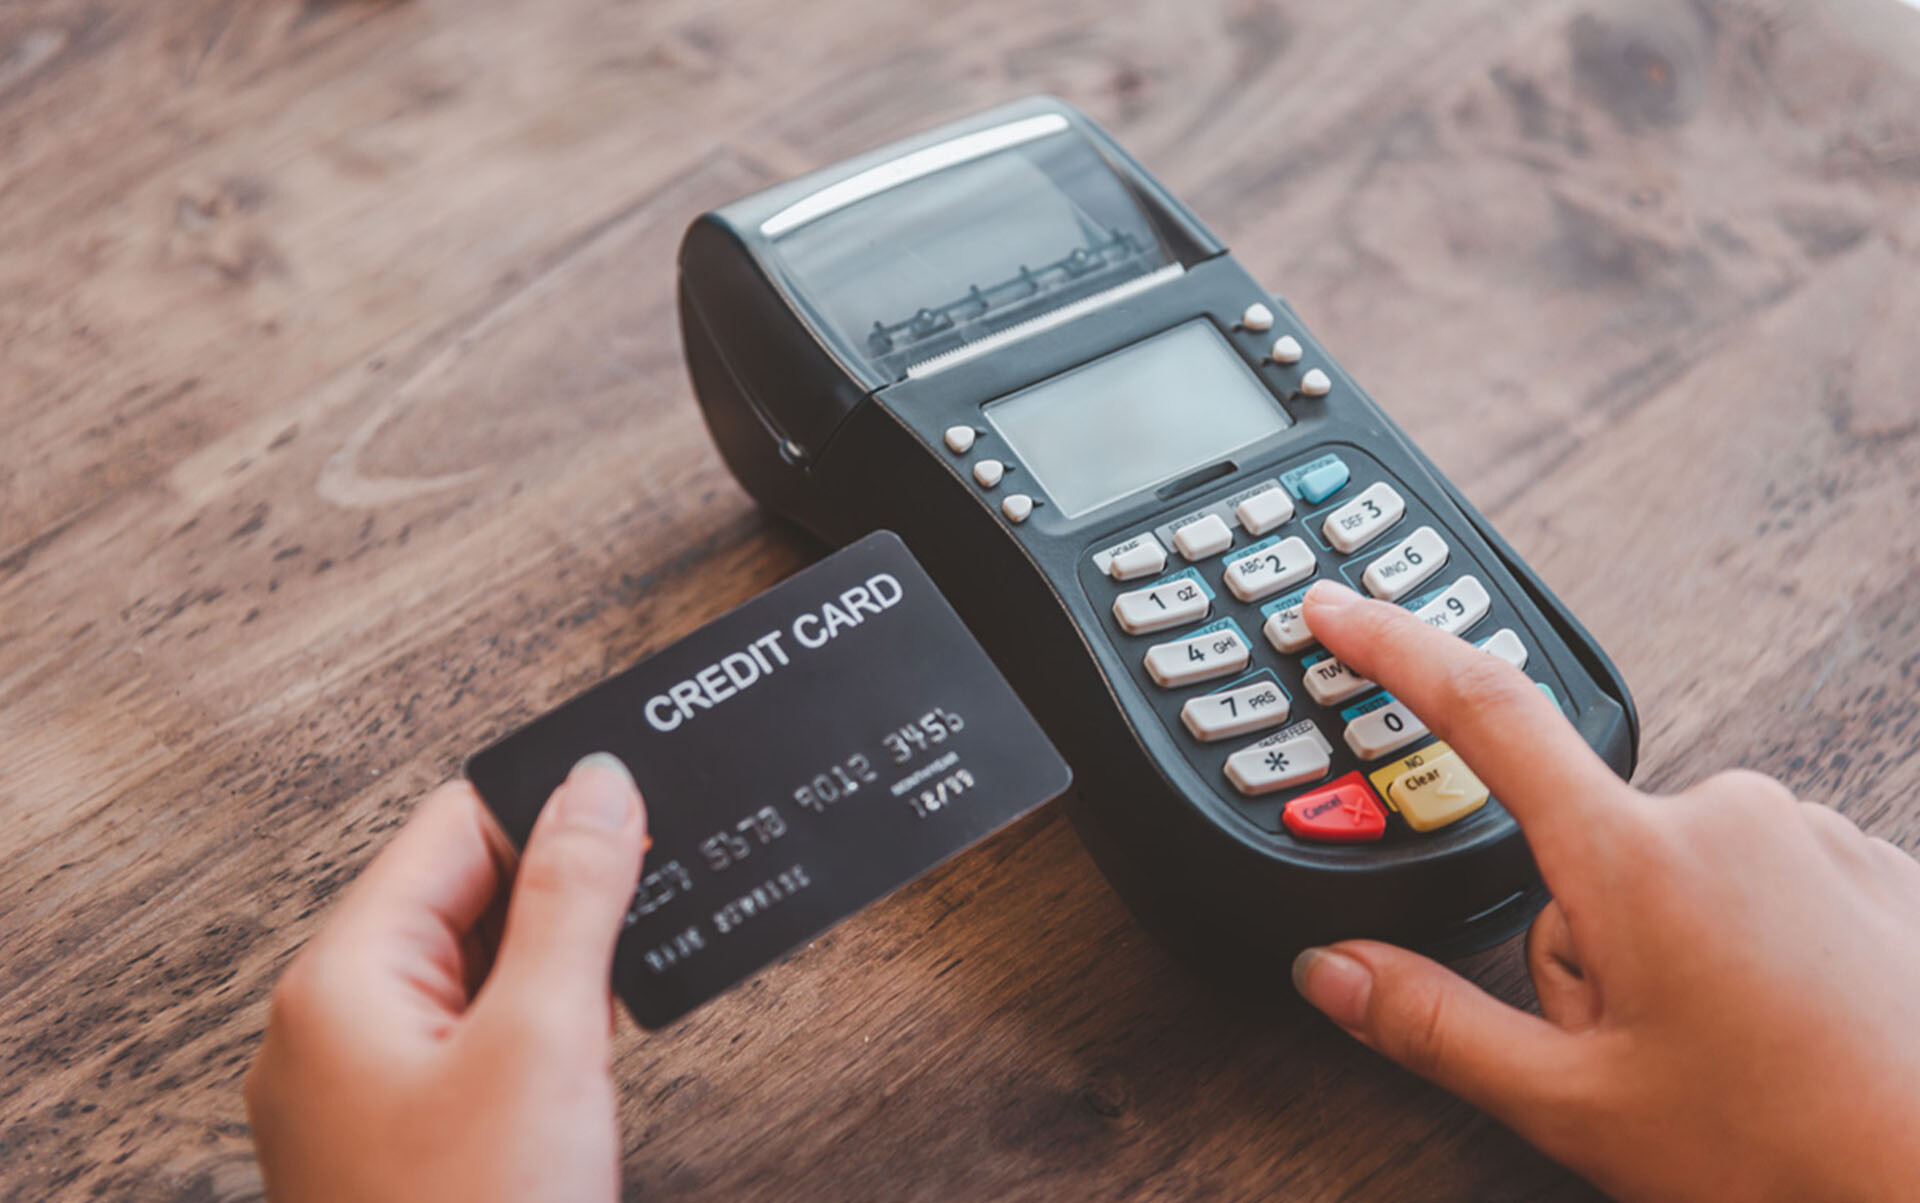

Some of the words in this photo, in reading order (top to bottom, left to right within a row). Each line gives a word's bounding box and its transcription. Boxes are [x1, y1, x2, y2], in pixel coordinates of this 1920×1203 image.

[1340, 513, 1363, 530] DEF
[1361, 500, 1382, 519] 3
[1239, 557, 1265, 575] ABC
[1265, 554, 1286, 573] 2
[1379, 560, 1408, 578] MNO
[1404, 546, 1423, 565] 6
[1149, 592, 1166, 609] 1
[1177, 585, 1198, 601] QZ
[1446, 597, 1464, 616] 9
[643, 629, 790, 732] CREDIT
[791, 573, 904, 649] CARD
[1187, 643, 1204, 662] 4
[1213, 636, 1238, 654] GHI
[1317, 661, 1343, 680] TUV
[1219, 697, 1238, 718] 7
[1248, 690, 1277, 709] PRS
[1383, 712, 1404, 732] 0
[882, 706, 965, 764] 3456
[1404, 754, 1425, 770] NO
[1404, 768, 1440, 791] Clear
[1302, 793, 1342, 820] Cancel
